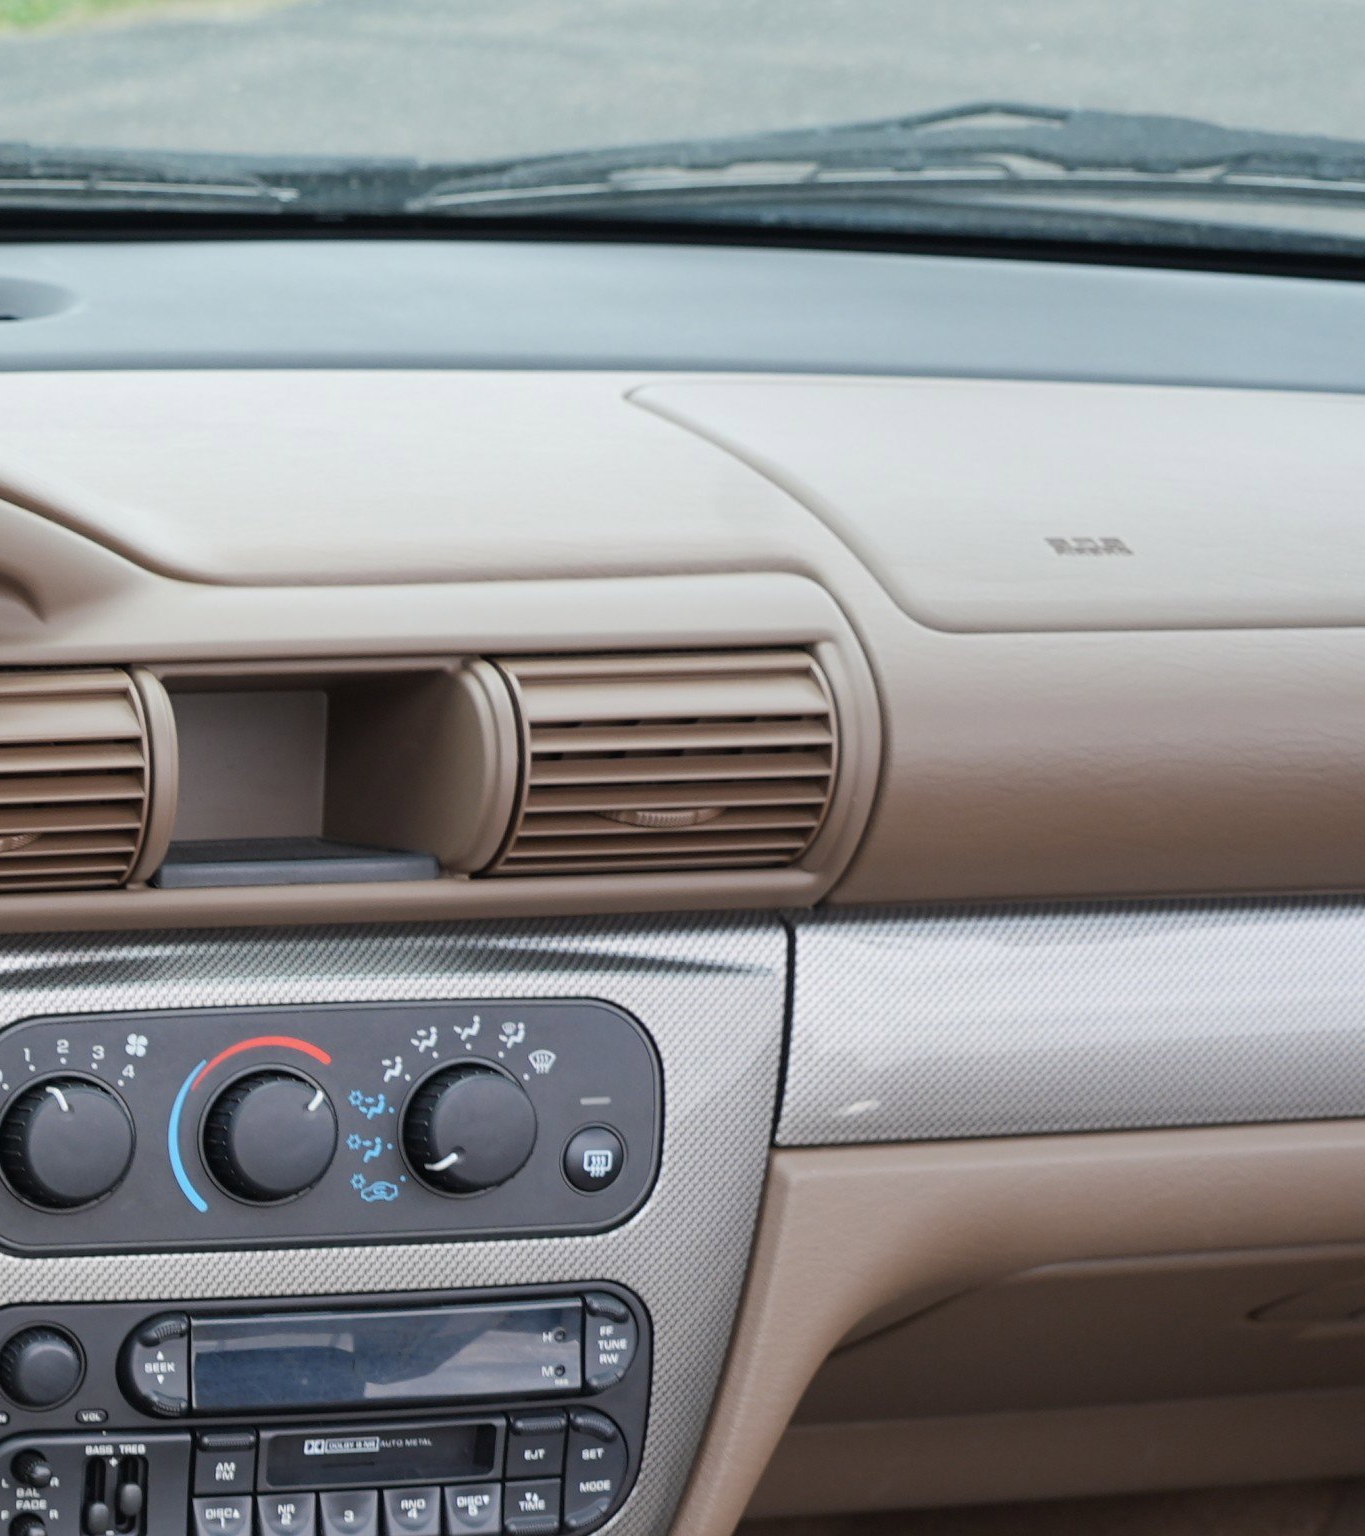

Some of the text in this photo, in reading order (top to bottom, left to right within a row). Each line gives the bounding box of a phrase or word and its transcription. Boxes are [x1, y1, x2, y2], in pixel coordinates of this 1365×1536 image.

[57, 1040, 69, 1053] 2
[24, 1048, 30, 1062] 1
[92, 1046, 105, 1060] 3
[122, 1065, 135, 1080] 4
[542, 1332, 552, 1342] H
[598, 1338, 628, 1350] TUNE
[599, 1353, 619, 1365] RW
[144, 1361, 176, 1374] SEEK
[541, 1365, 554, 1377] M
[81, 1412, 102, 1422] VOL
[380, 1437, 432, 1448] AUTO METAL
[85, 1443, 146, 1456] BASS TREB
[524, 1448, 545, 1461] EJT
[581, 1448, 604, 1460] SET
[215, 1462, 236, 1471] AM
[215, 1470, 235, 1481] FM
[1, 1478, 9, 1488] L
[579, 1480, 611, 1493] MODE
[16, 1487, 40, 1498] BAL
[16, 1499, 47, 1510] FADE
[519, 1500, 546, 1512] TIME
[344, 1510, 354, 1523] 3
